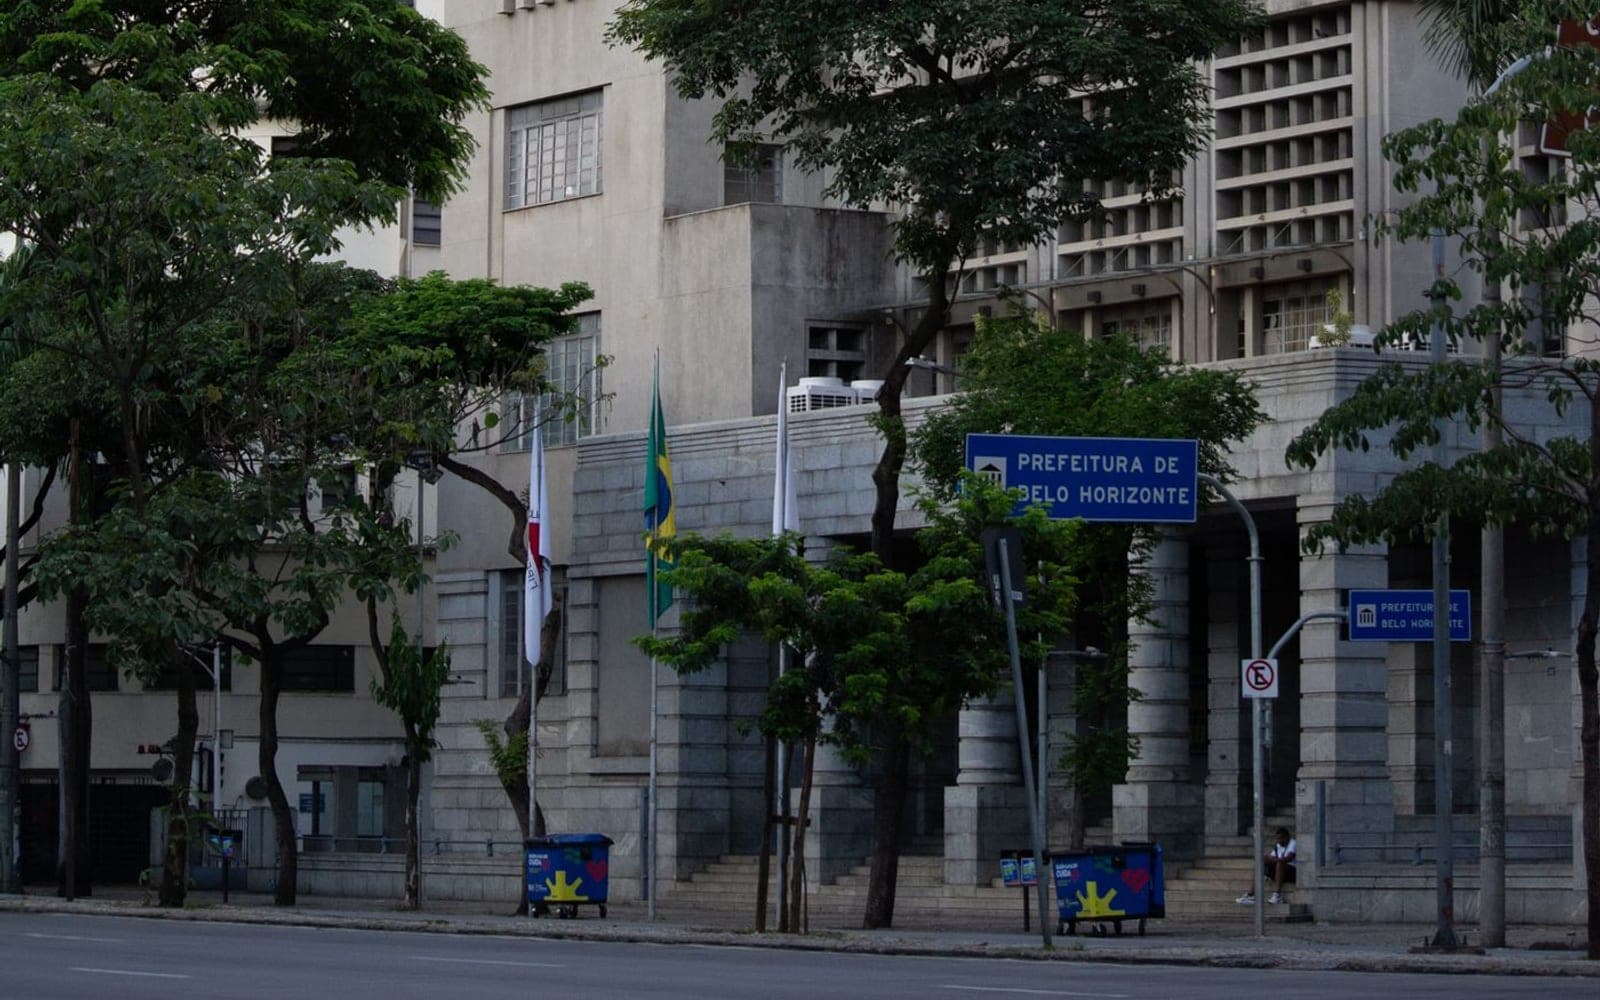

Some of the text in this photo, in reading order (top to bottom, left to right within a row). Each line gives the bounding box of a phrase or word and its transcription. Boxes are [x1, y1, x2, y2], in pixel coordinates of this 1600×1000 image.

[1018, 453, 1179, 474] PREFEITURA DE
[1018, 484, 1189, 505] BELO HORIZONTE
[1381, 603, 1435, 612] PREFEITUR
[1381, 619, 1406, 628] BELO
